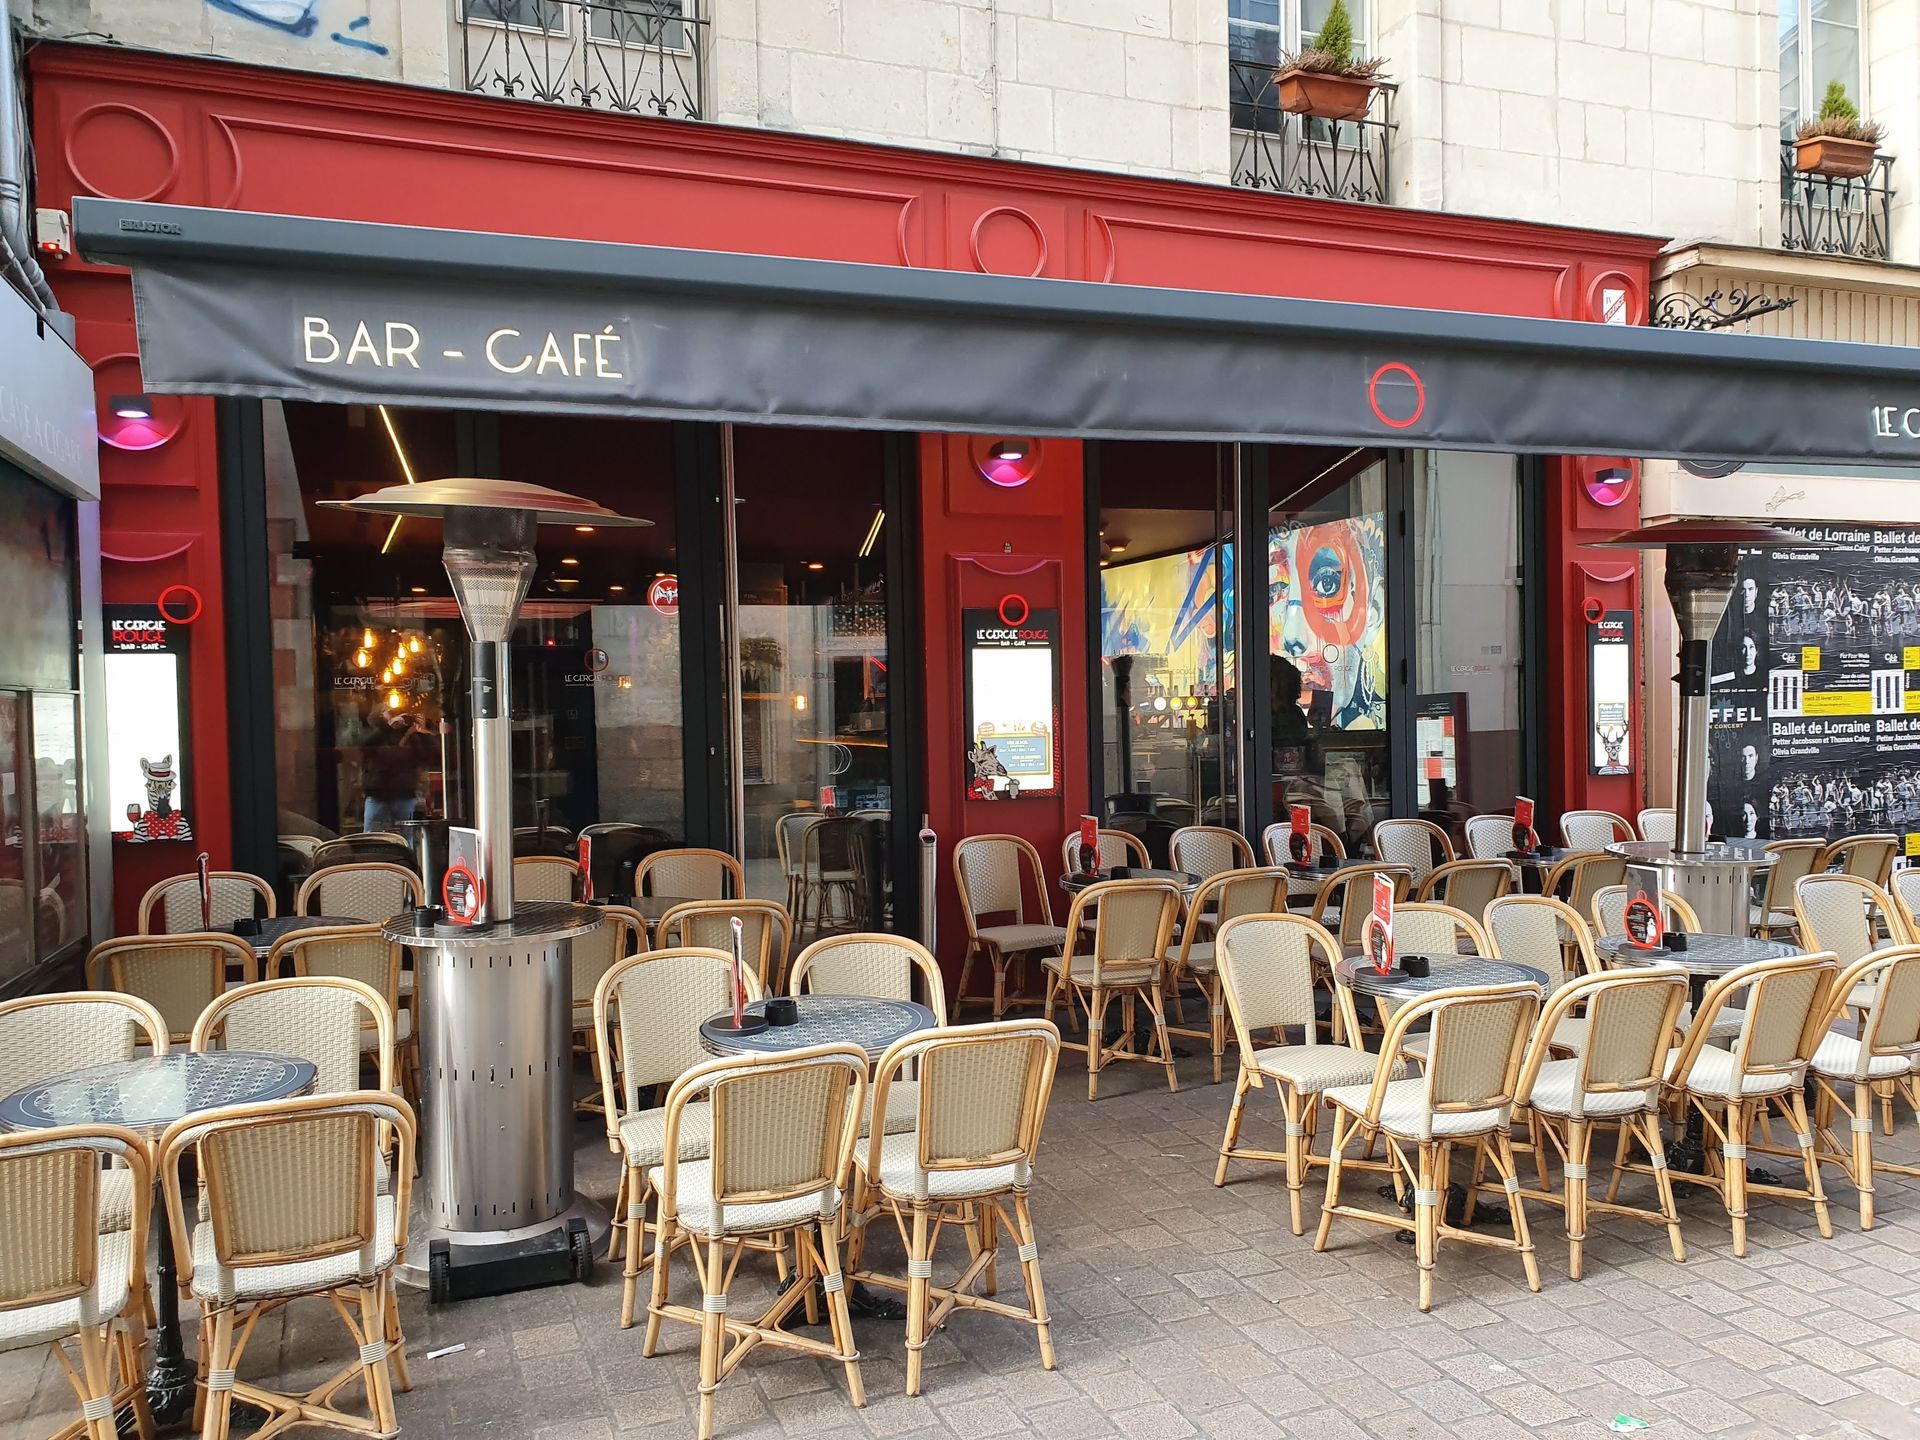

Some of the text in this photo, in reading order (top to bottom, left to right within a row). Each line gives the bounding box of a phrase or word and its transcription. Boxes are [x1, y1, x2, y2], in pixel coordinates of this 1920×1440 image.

[120, 219, 182, 235] BRUSTOR
[303, 316, 420, 369] BAR
[485, 324, 623, 379] CAFÉ
[1874, 406, 1900, 437] LE
[1809, 529, 1822, 541] de
[1825, 528, 1870, 542] Lorraine
[1874, 531, 1906, 543] Ballet
[1790, 552, 1820, 561] Grandville
[112, 620, 166, 630] LE CERCLE
[112, 630, 166, 642] ROUGE
[977, 630, 1049, 640] LE CERCLE ROUGE
[141, 642, 160, 650] CAFÉ
[334, 677, 342, 685] LE
[343, 676, 374, 685] CERCLE
[564, 674, 572, 682] LE
[573, 674, 601, 682] CERCLE
[1773, 720, 1871, 735] Ballet de Lorraine
[1876, 719, 1908, 732] Ballet
[1791, 737, 1822, 745] Jacobsson
[1772, 747, 1820, 756] Olivia Grandville
